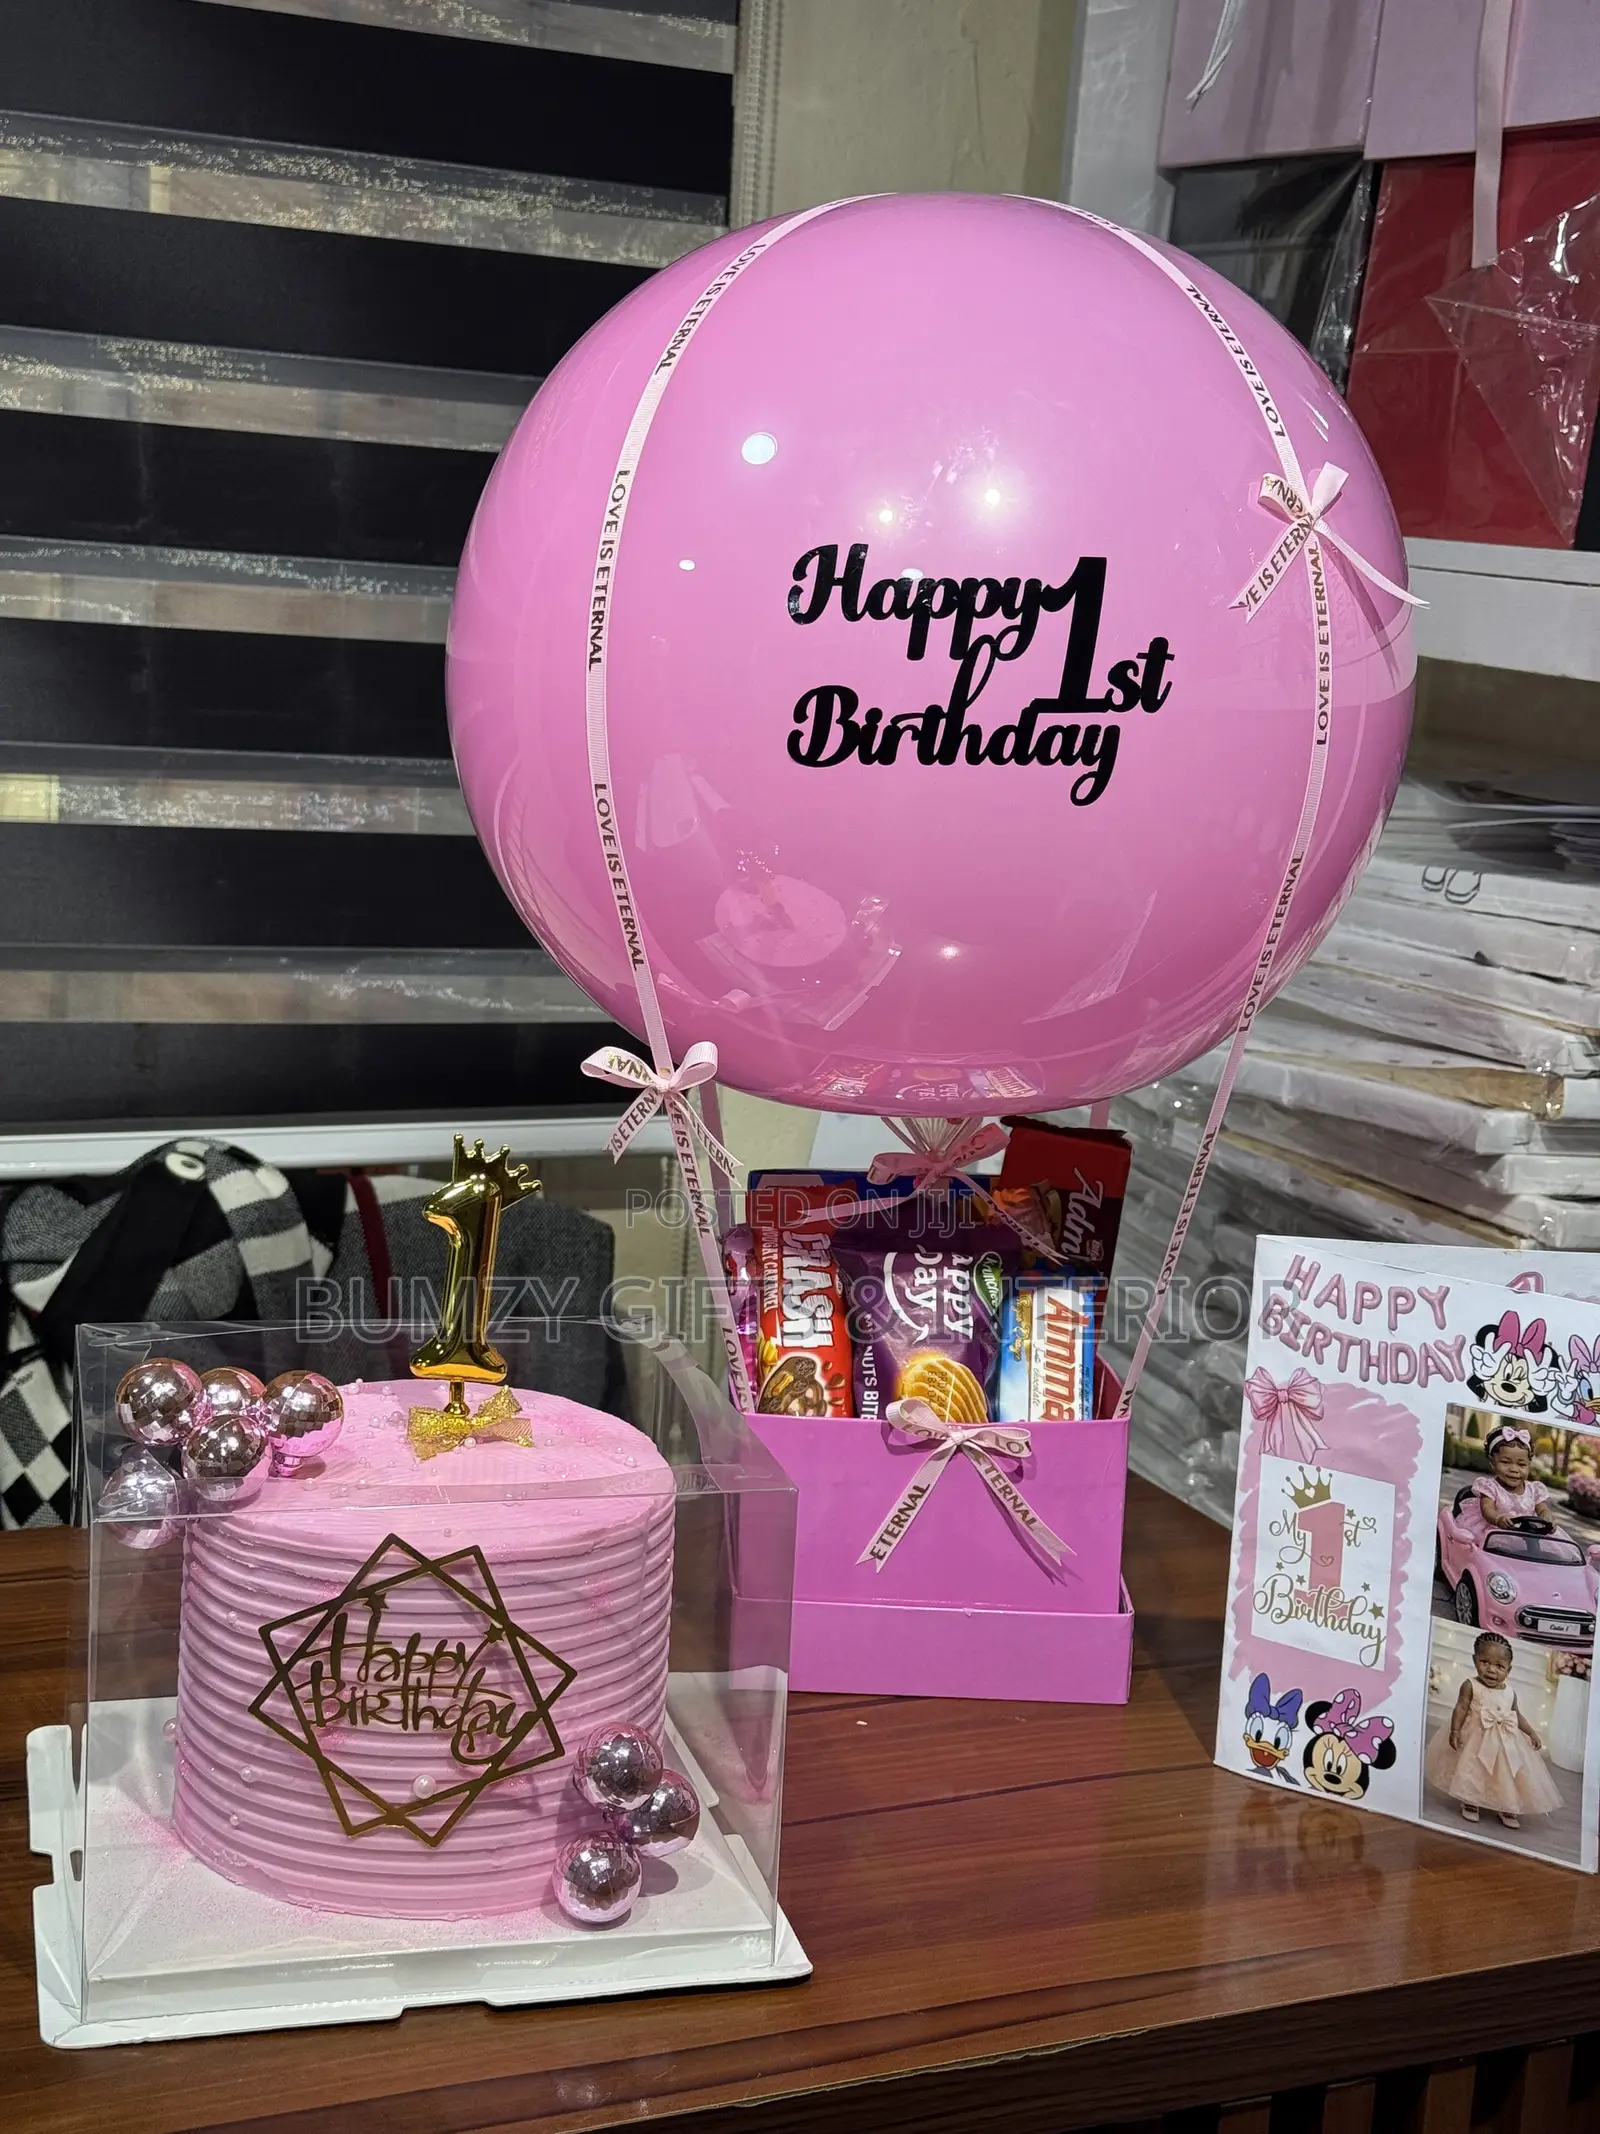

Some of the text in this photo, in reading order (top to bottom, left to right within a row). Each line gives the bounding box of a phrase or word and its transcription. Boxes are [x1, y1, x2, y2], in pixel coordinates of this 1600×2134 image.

[655, 244, 767, 376] LOVE IS ETERNAL
[1185, 284, 1287, 438] LOVE IS ETERNAL
[588, 470, 631, 672] LOVE IS ETERNAL
[787, 543, 1043, 661] Happy
[1258, 568, 1275, 592] IS
[1310, 541, 1331, 746] LOVE IS ETERNAL
[786, 635, 1121, 807] Birthday
[594, 783, 645, 972] LOVE IS ETERNAL
[1239, 851, 1305, 1033] LOVE IS ETERNAL
[675, 1130, 690, 1149] IS
[681, 1152, 712, 1239] ETERNAL
[1156, 1126, 1218, 1296] LOVE IS ETERNAL
[763, 1261, 780, 1314] CARAMEL
[781, 1230, 836, 1348] CRASH
[943, 1253, 974, 1340] appy
[1283, 1254, 1450, 1331] HAPPY
[722, 1327, 745, 1382] LOVE
[1258, 1293, 1466, 1389] BIRTHDAY
[869, 1482, 931, 1562] ETERNAL
[1269, 1509, 1320, 1567] My
[300, 1594, 495, 1699] Happy
[1253, 1573, 1387, 1668] Birthday
